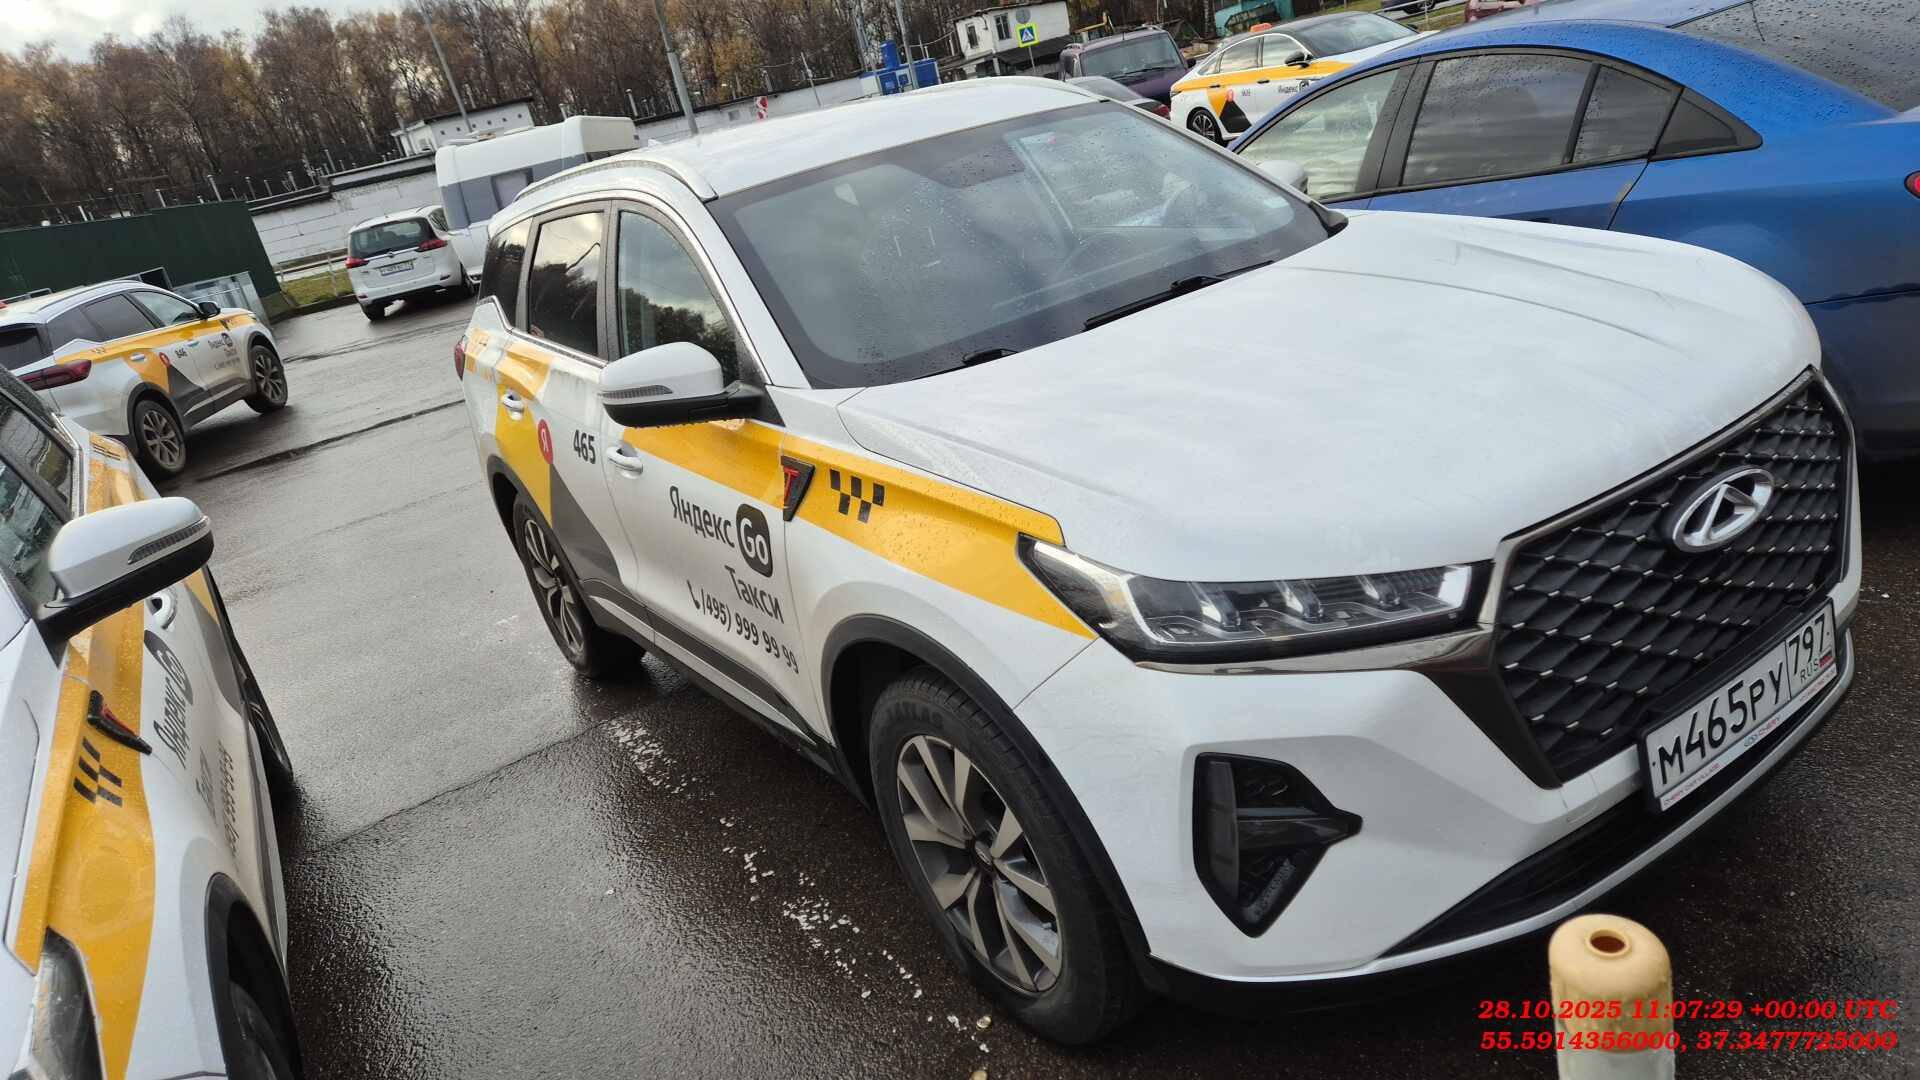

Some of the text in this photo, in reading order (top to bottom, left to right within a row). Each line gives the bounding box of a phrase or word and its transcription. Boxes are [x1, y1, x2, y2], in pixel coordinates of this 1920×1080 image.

[573, 429, 596, 464] 465
[669, 485, 769, 566] Яндекс Go
[701, 588, 800, 675] (495) 999 99 99
[724, 564, 785, 624] Такси
[1657, 661, 1784, 785] М465РУ
[1788, 612, 1826, 676] 797
[1799, 657, 1820, 685] RUS
[153, 676, 190, 770] Яндекс
